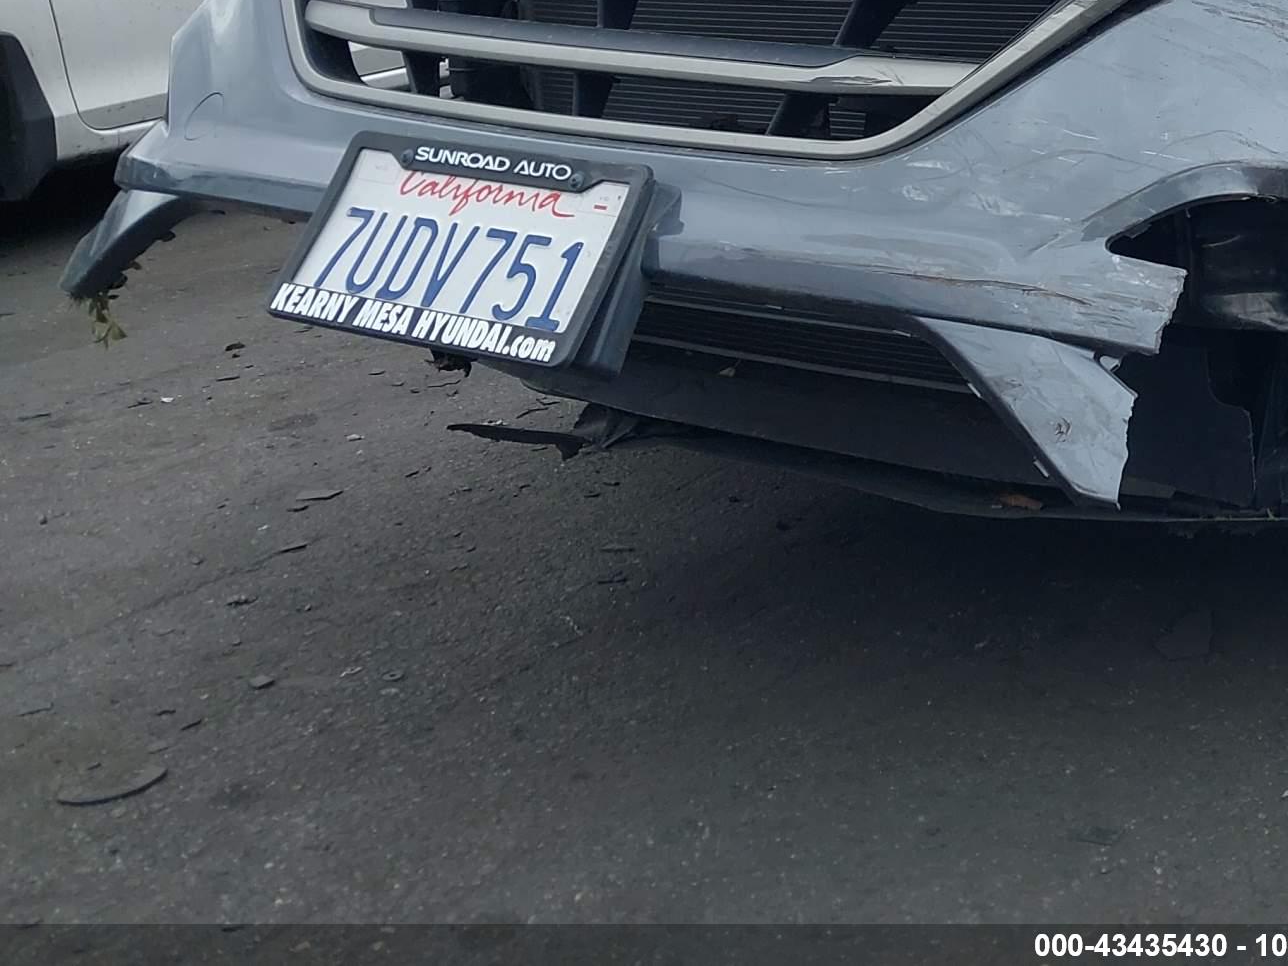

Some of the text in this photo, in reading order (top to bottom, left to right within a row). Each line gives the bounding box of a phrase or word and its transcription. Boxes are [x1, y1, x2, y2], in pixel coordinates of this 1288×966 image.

[401, 171, 575, 218] California
[415, 147, 572, 180] SUNROAD AUTO
[314, 207, 584, 332] 7UDV751
[270, 283, 556, 363] KEARNY MESA HYUNDAI.com
